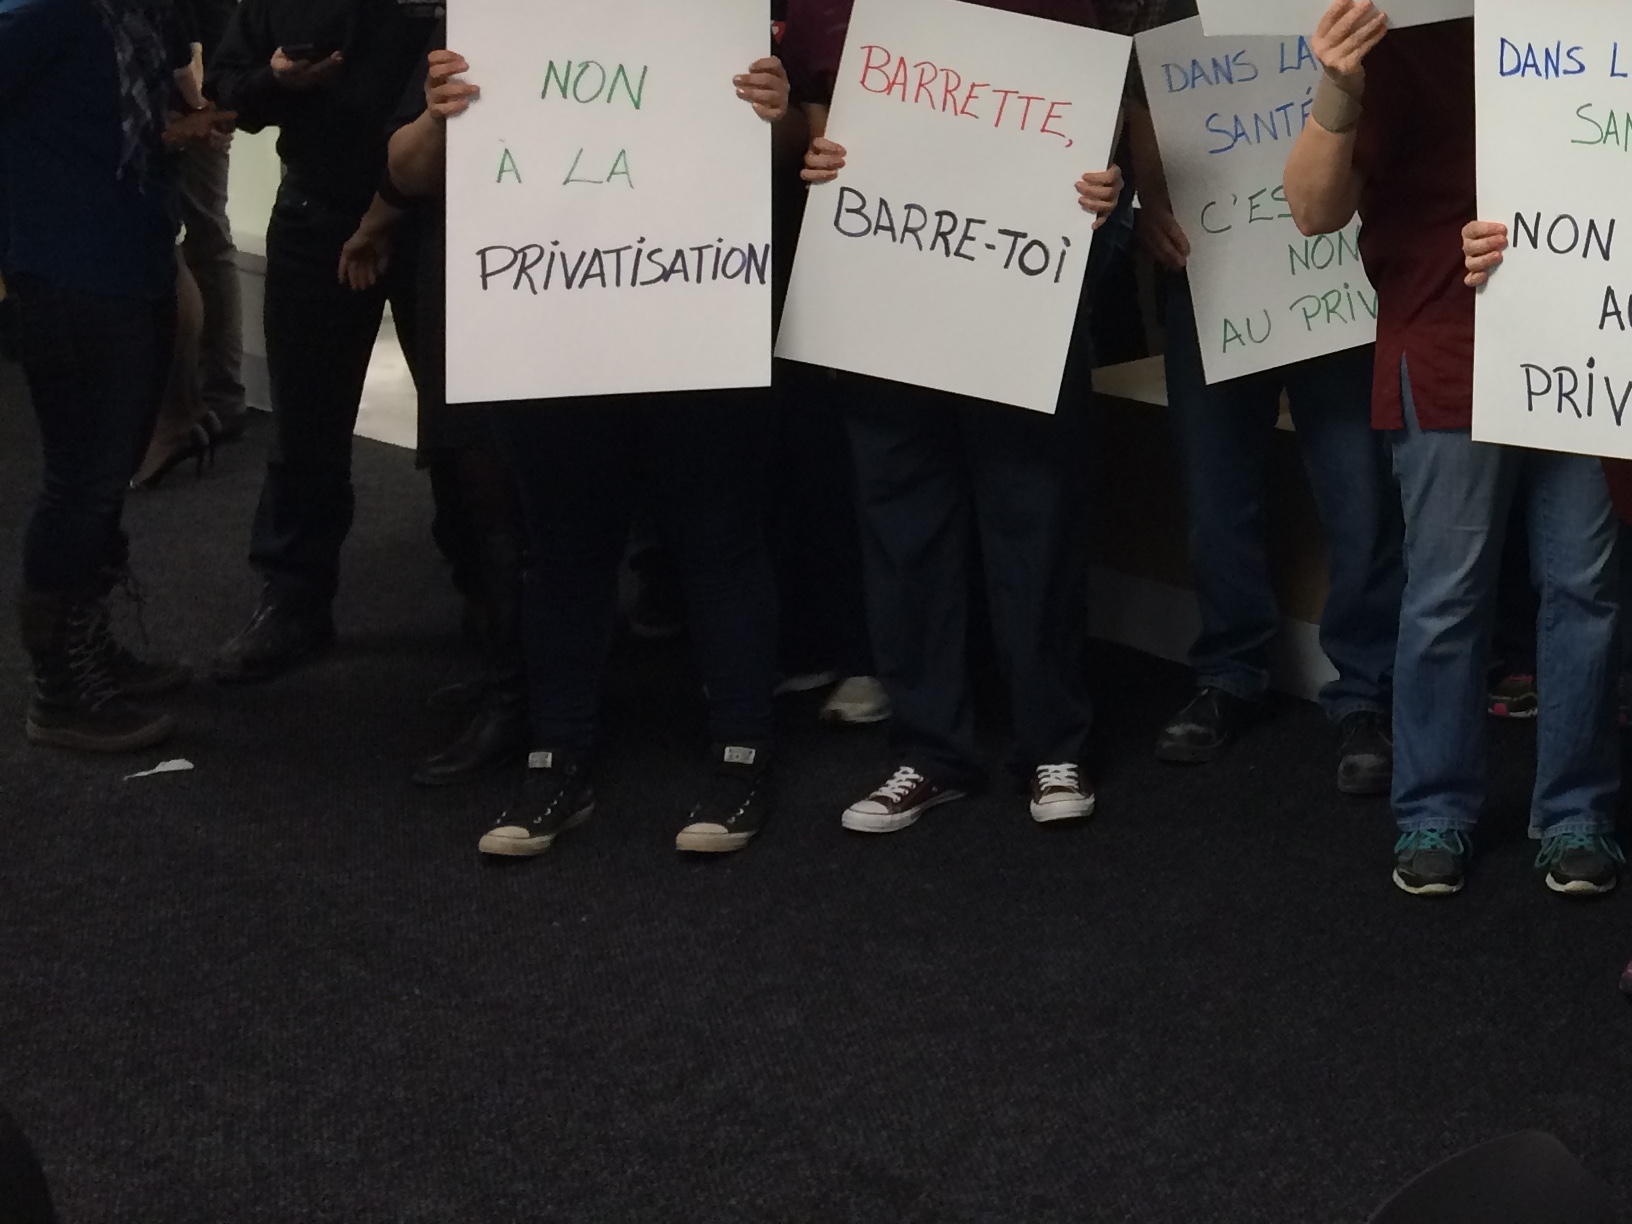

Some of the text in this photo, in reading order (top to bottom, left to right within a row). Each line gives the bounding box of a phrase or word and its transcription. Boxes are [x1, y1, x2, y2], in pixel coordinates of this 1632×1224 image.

[540, 60, 648, 110] NON
[1162, 35, 1318, 93] DANS LA
[1499, 38, 1585, 80] DANS
[859, 45, 1074, 149] BARRETTE,
[562, 147, 635, 189] LA
[833, 186, 1072, 284] BARRE-TOI
[1288, 224, 1361, 276] NON
[1512, 212, 1616, 261] NON
[475, 236, 771, 295] PRIVATISATION
[1221, 282, 1377, 353] AU PRIV
